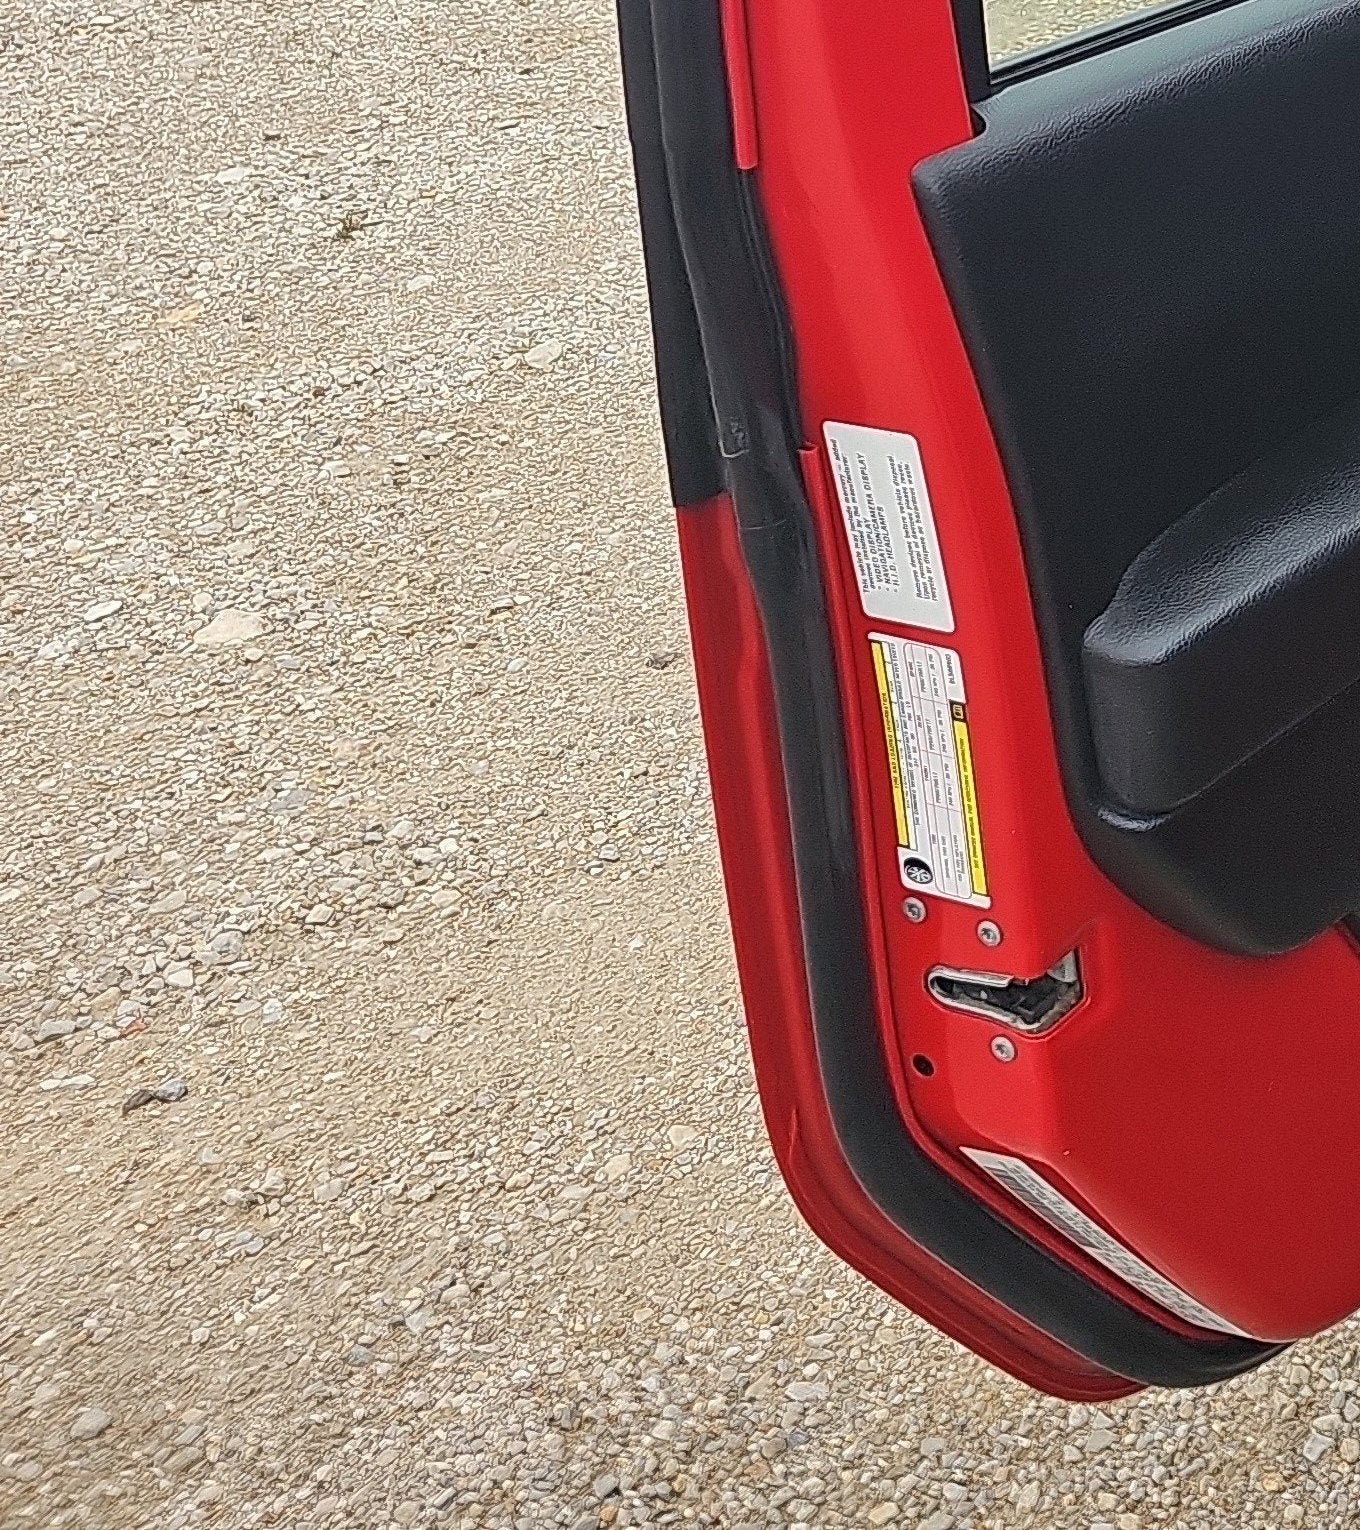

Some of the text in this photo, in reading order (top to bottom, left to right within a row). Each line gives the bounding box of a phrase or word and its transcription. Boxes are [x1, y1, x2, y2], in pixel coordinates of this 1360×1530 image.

[857, 453, 870, 489] DISPLAY
[864, 518, 882, 582] VIDEO DISPLAY
